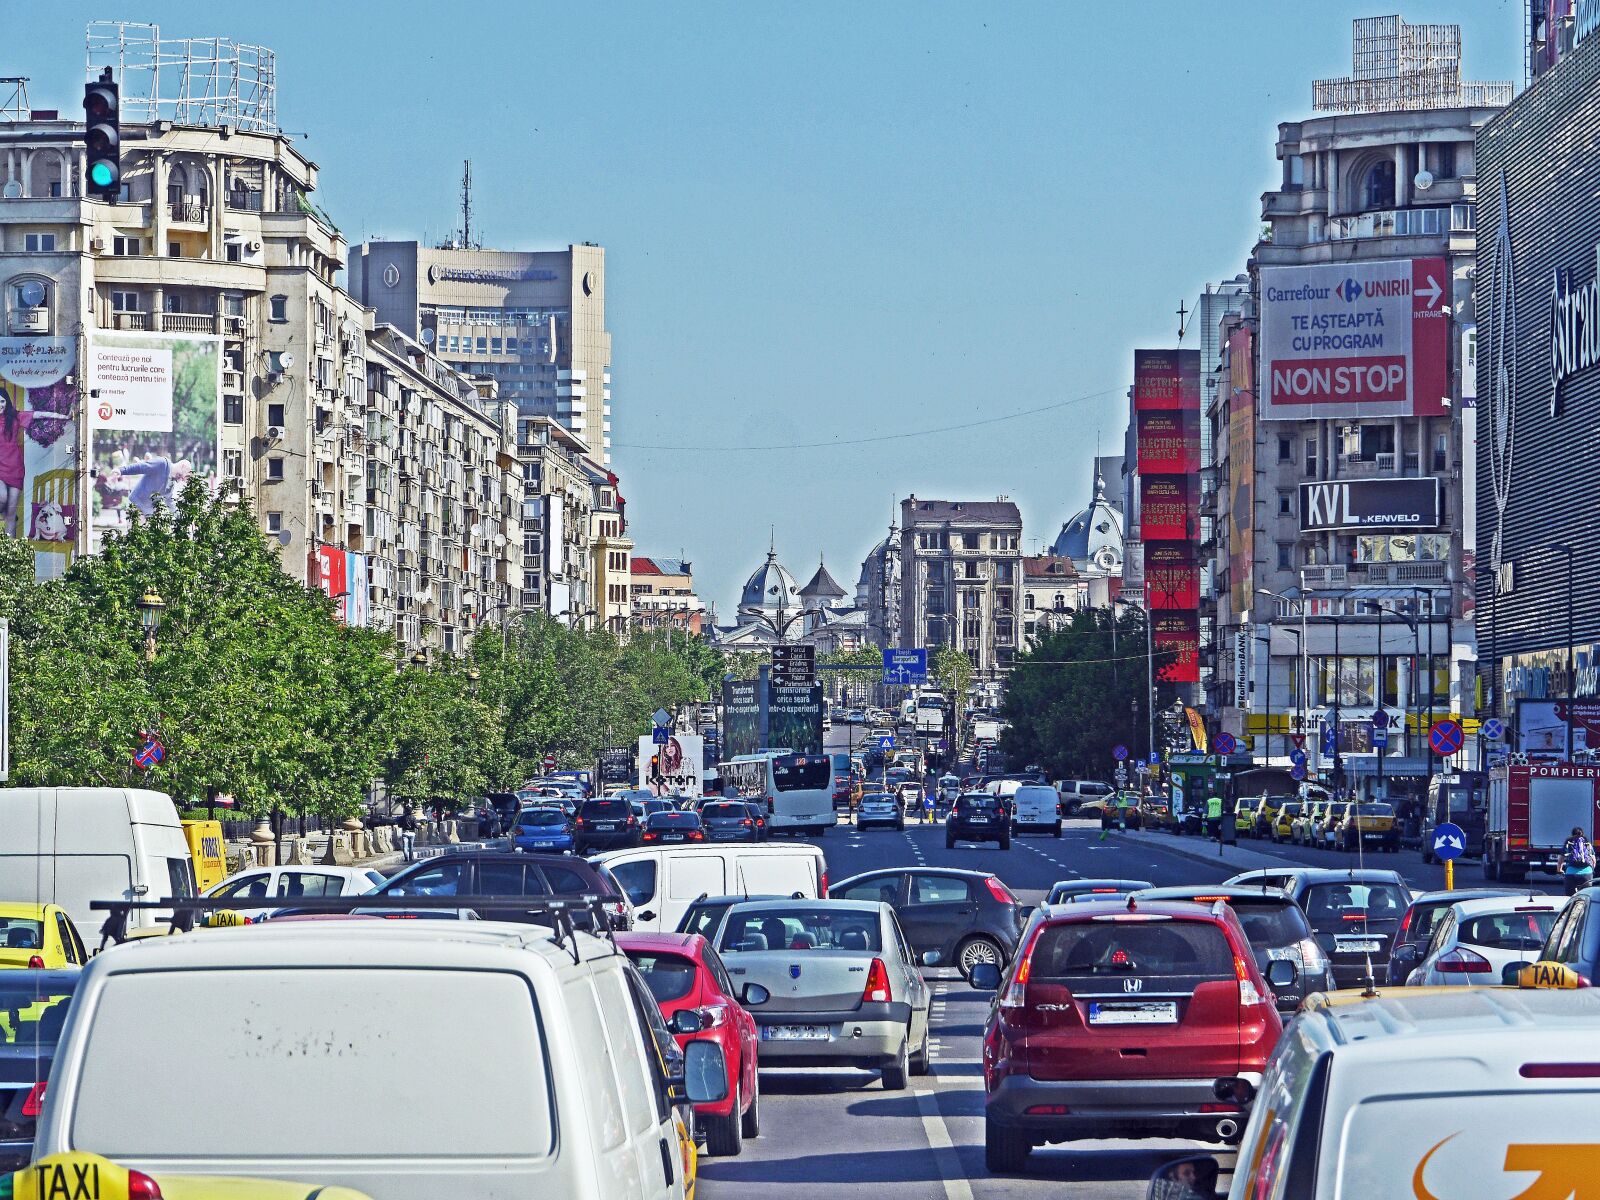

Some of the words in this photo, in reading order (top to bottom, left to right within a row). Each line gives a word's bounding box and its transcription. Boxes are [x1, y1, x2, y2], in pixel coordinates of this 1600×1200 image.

[1267, 284, 1331, 302] Carrefour
[1364, 279, 1410, 298] UNIRII
[1291, 315, 1309, 330] TE
[1311, 308, 1385, 334] AȘTEAPTĂ
[1413, 310, 1443, 319] INTRARE
[1292, 336, 1311, 351] CU
[1313, 334, 1384, 350] PROGRAM
[121, 364, 148, 372] lucrurile
[1273, 367, 1331, 396] NON
[1334, 364, 1404, 394] STOP
[1308, 484, 1360, 526] KVL
[1368, 514, 1420, 522] KENVELO
[1238, 632, 1246, 700] RaiffeisenBANK
[794, 694, 810, 703] seară
[786, 704, 818, 714] experiență
[646, 774, 696, 785] KOTON
[1530, 767, 1600, 777] POMPIERI
[216, 913, 236, 926] TAXI
[1532, 966, 1565, 986] TAXI
[36, 1164, 100, 1200] TAXI
